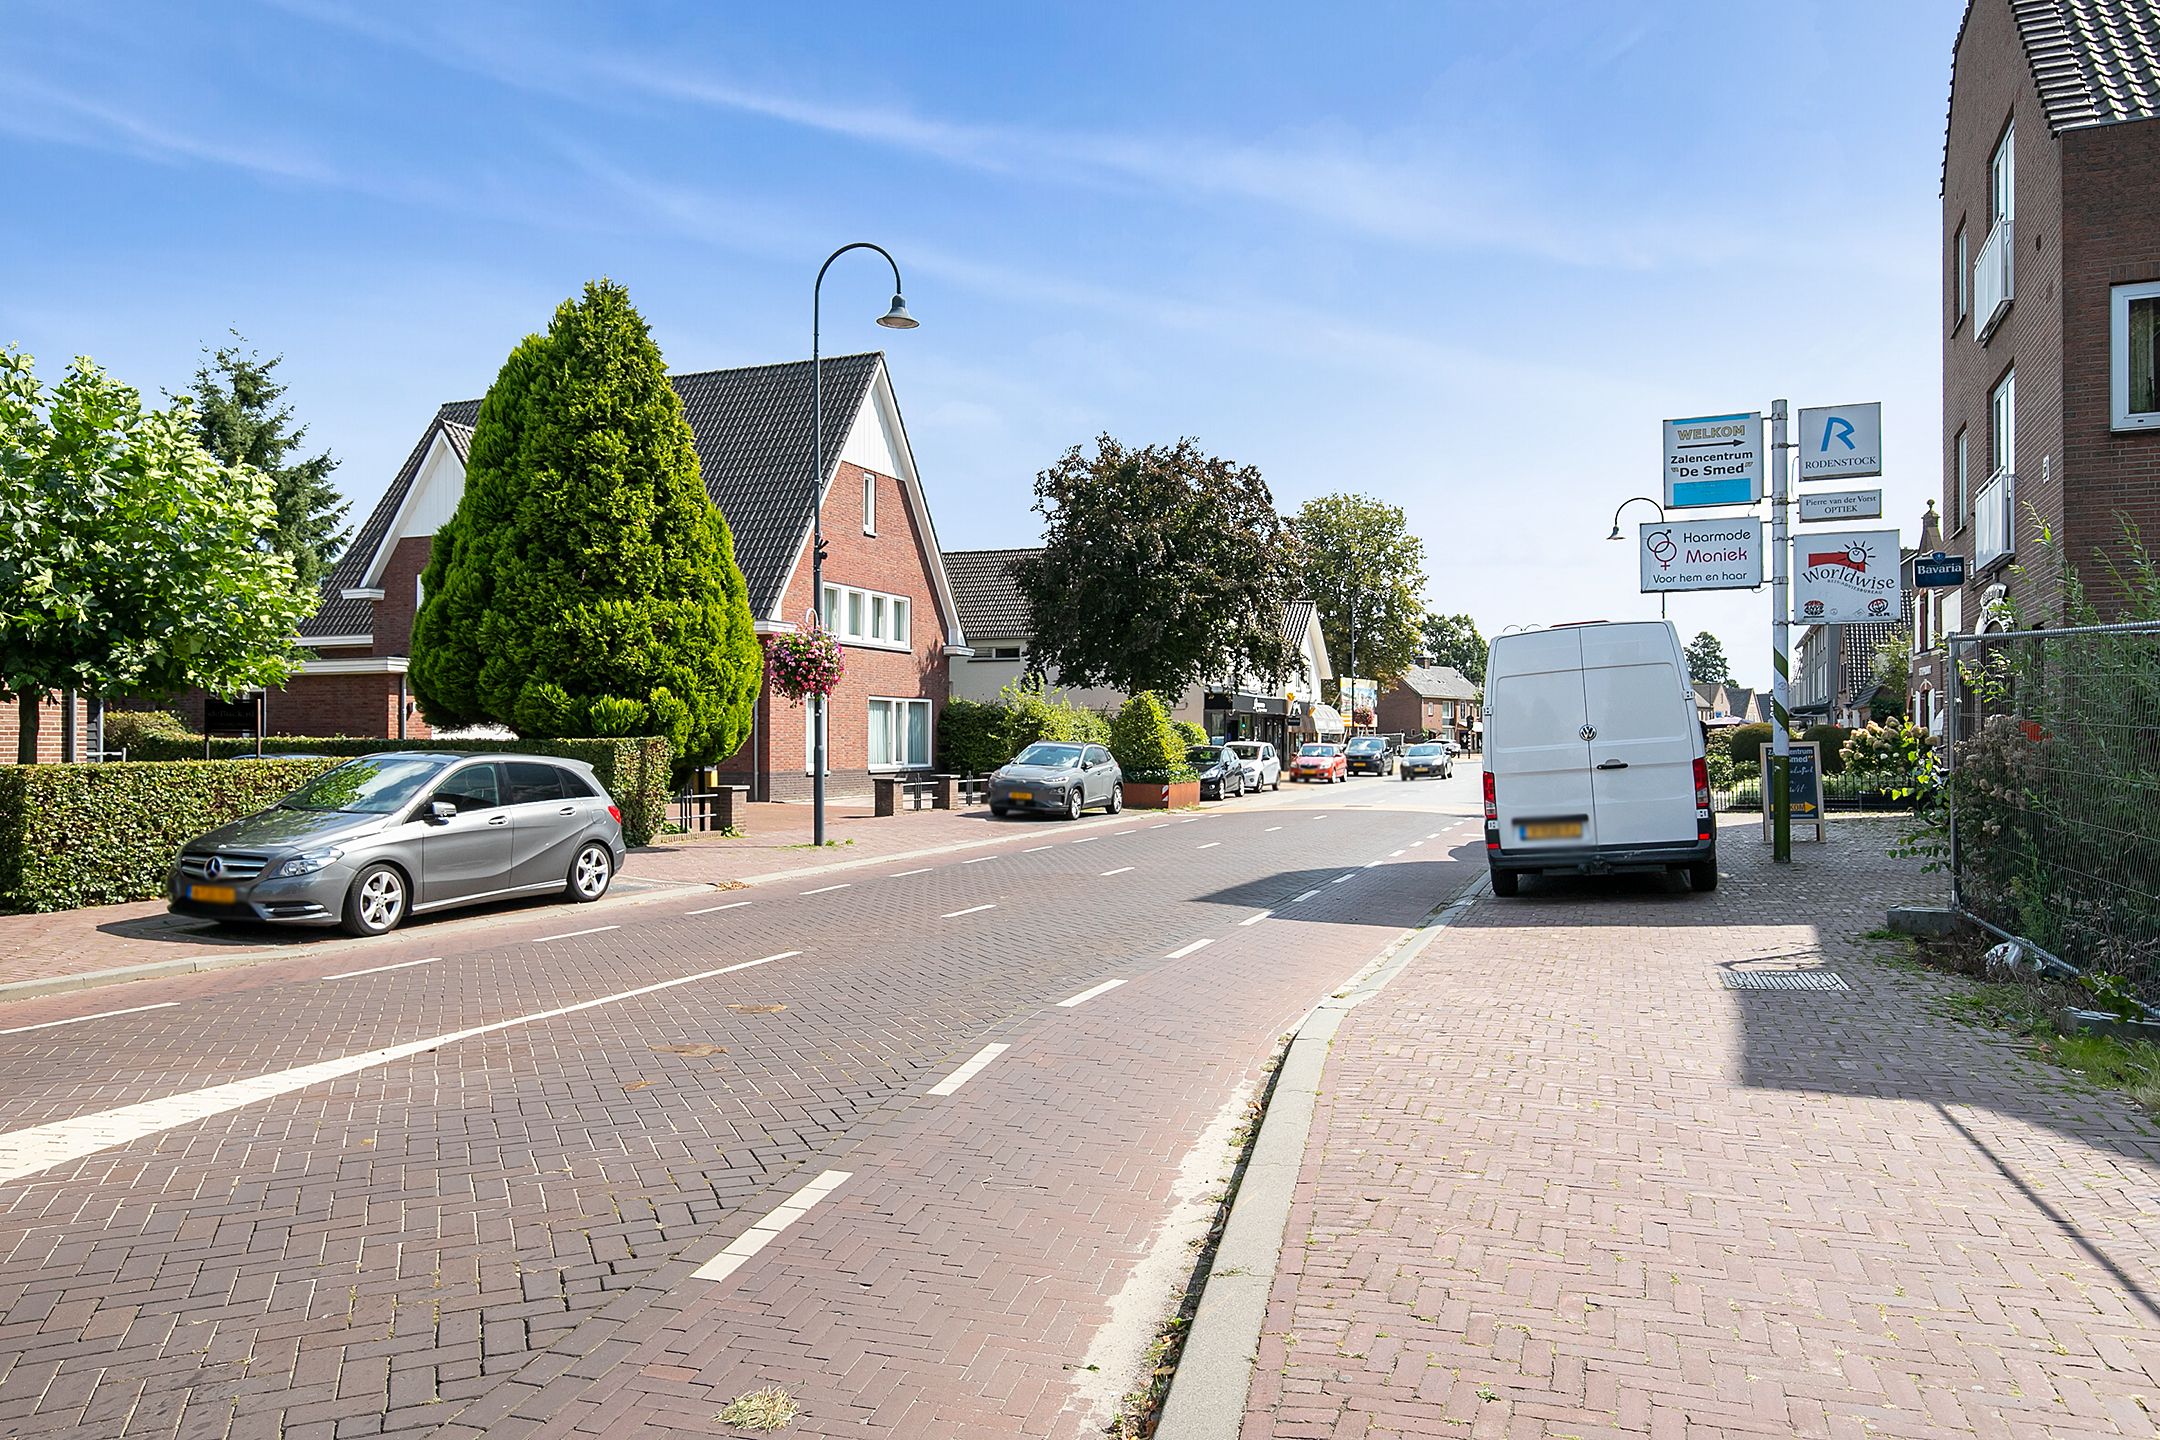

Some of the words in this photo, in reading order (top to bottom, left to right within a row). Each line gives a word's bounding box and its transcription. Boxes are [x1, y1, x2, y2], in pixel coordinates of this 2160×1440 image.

[1678, 425, 1745, 440] WELKOM
[1821, 417, 1855, 451] R
[1671, 452, 1753, 464] Zalencentrum
[1805, 456, 1876, 469] RODENSTOCK
[1824, 505, 1858, 514] OPTIEK
[1683, 529, 1751, 543] Haarmode
[1686, 547, 1747, 564] Moniek
[1917, 563, 1962, 574] Bavaria
[1653, 575, 1676, 583] Voor
[1680, 573, 1702, 582] hem
[1722, 571, 1747, 580] haar
[1802, 566, 1895, 590] Worldwise
